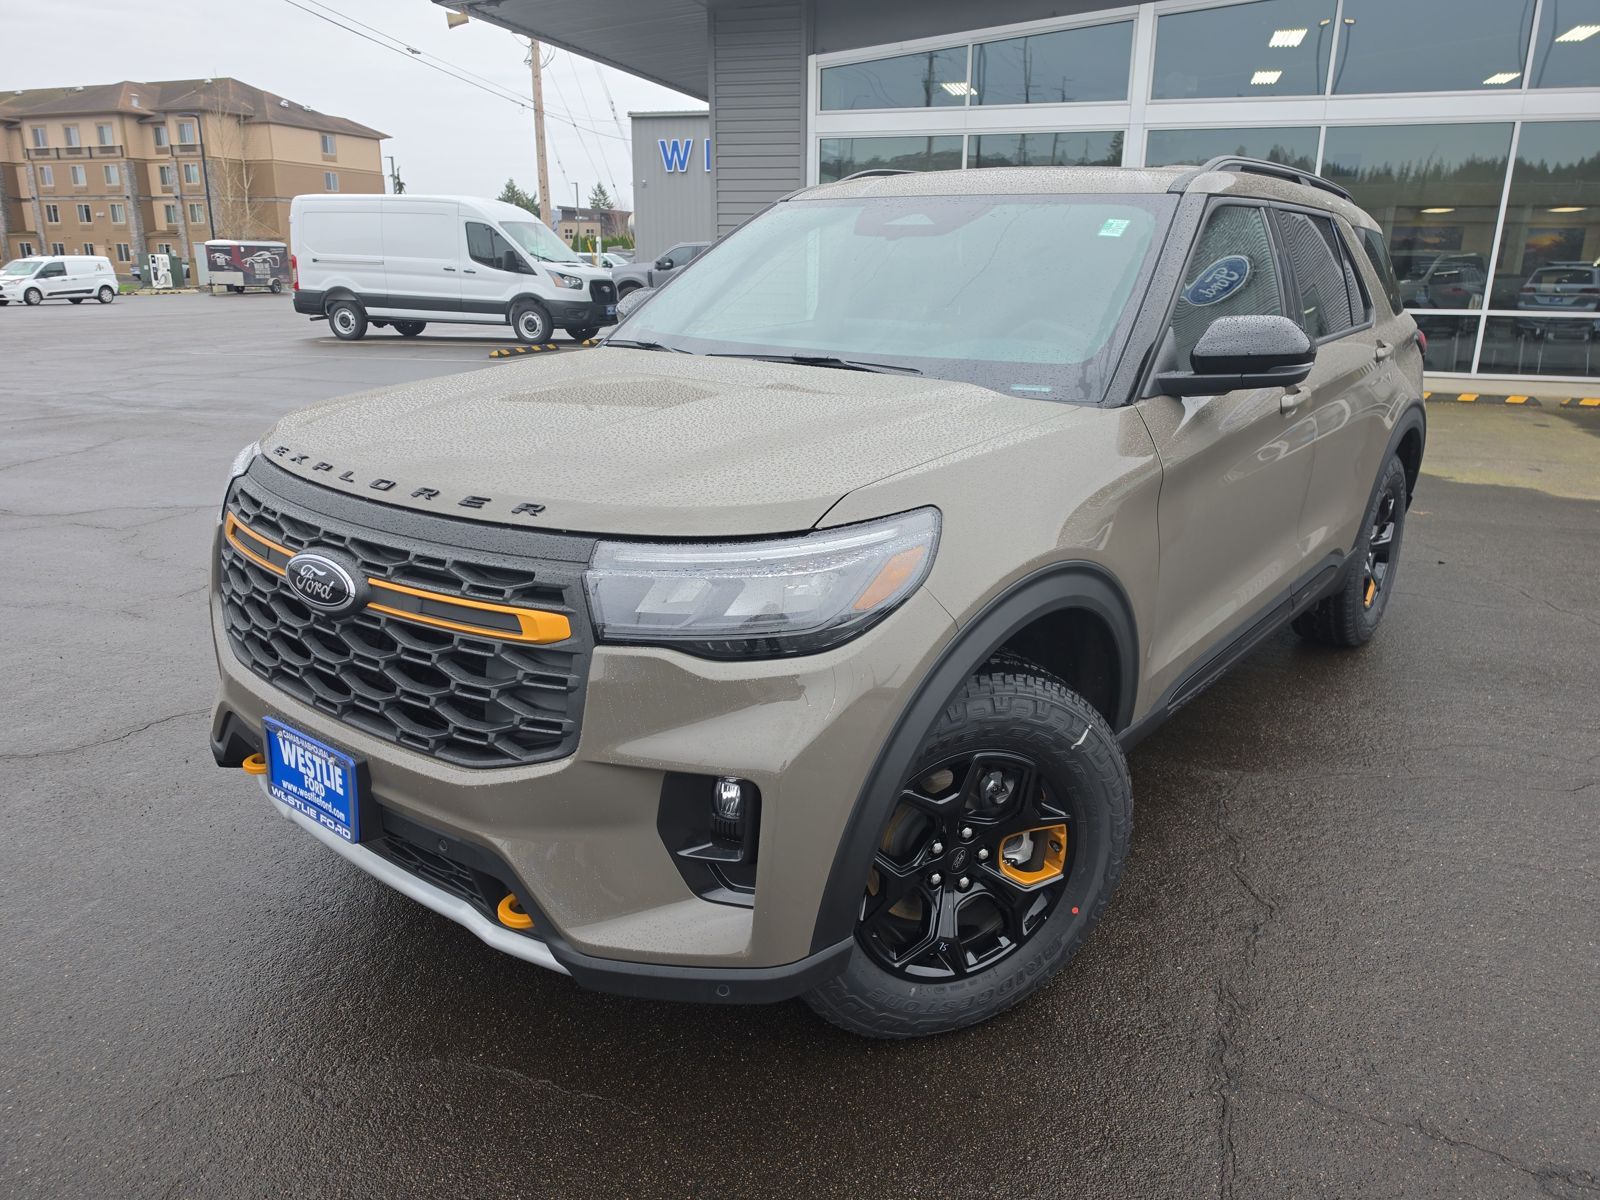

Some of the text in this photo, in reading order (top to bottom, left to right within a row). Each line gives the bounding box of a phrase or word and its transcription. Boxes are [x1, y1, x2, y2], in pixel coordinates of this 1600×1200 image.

[272, 445, 546, 516] EXPLORER
[296, 564, 335, 600] Ford
[278, 737, 344, 796] WESTLIE
[304, 774, 325, 797] FORD
[271, 785, 351, 840] WESTLIE FORD
[281, 779, 346, 822] www.westlieford.com
